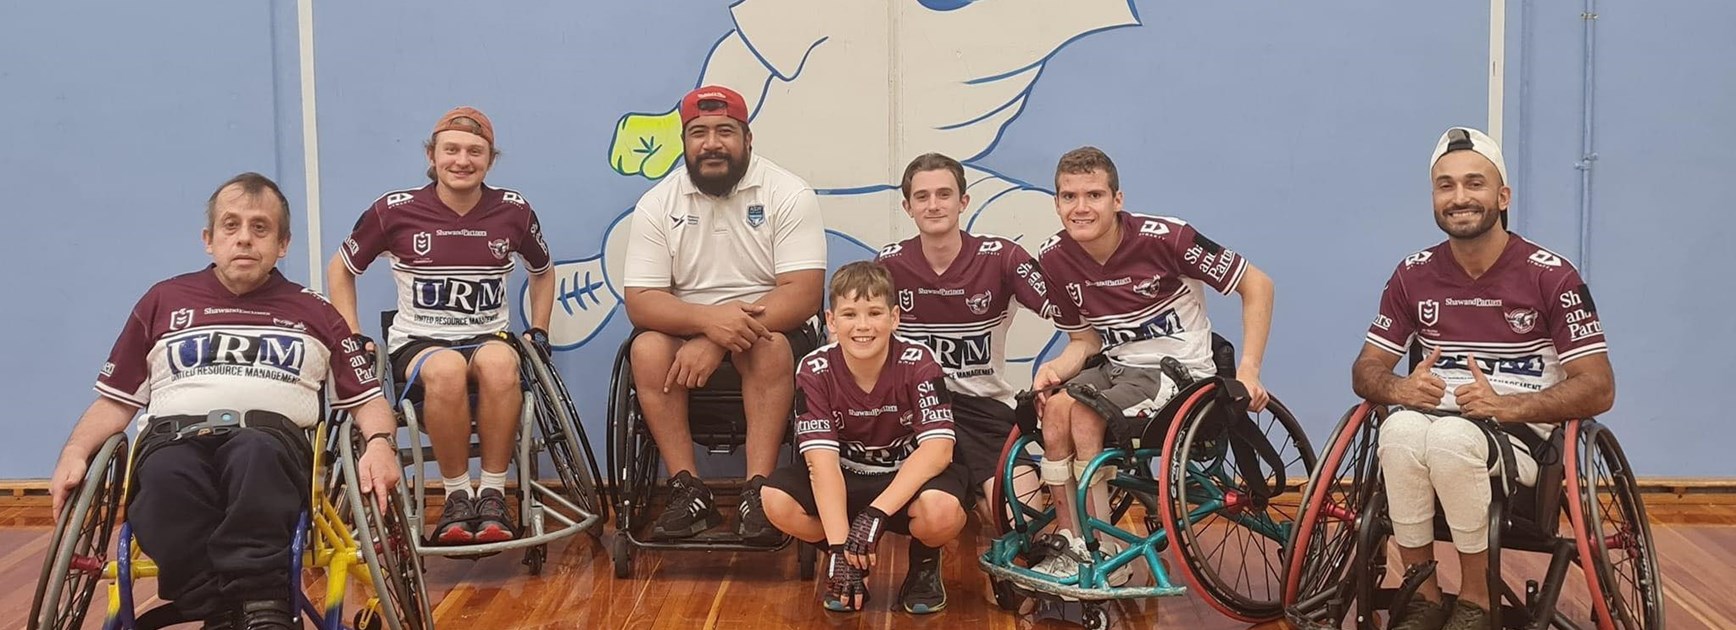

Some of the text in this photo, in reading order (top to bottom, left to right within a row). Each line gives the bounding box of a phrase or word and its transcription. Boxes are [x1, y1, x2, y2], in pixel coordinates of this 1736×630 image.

[1016, 262, 1033, 279] Sh
[1028, 271, 1042, 287] an
[415, 280, 504, 312] URM
[1560, 290, 1582, 309] Sh
[168, 332, 304, 372] URM
[341, 337, 360, 354] Sh
[197, 363, 242, 376] RESOURCE
[350, 355, 367, 368] an
[917, 380, 934, 397] Sh
[798, 419, 830, 432] tners
